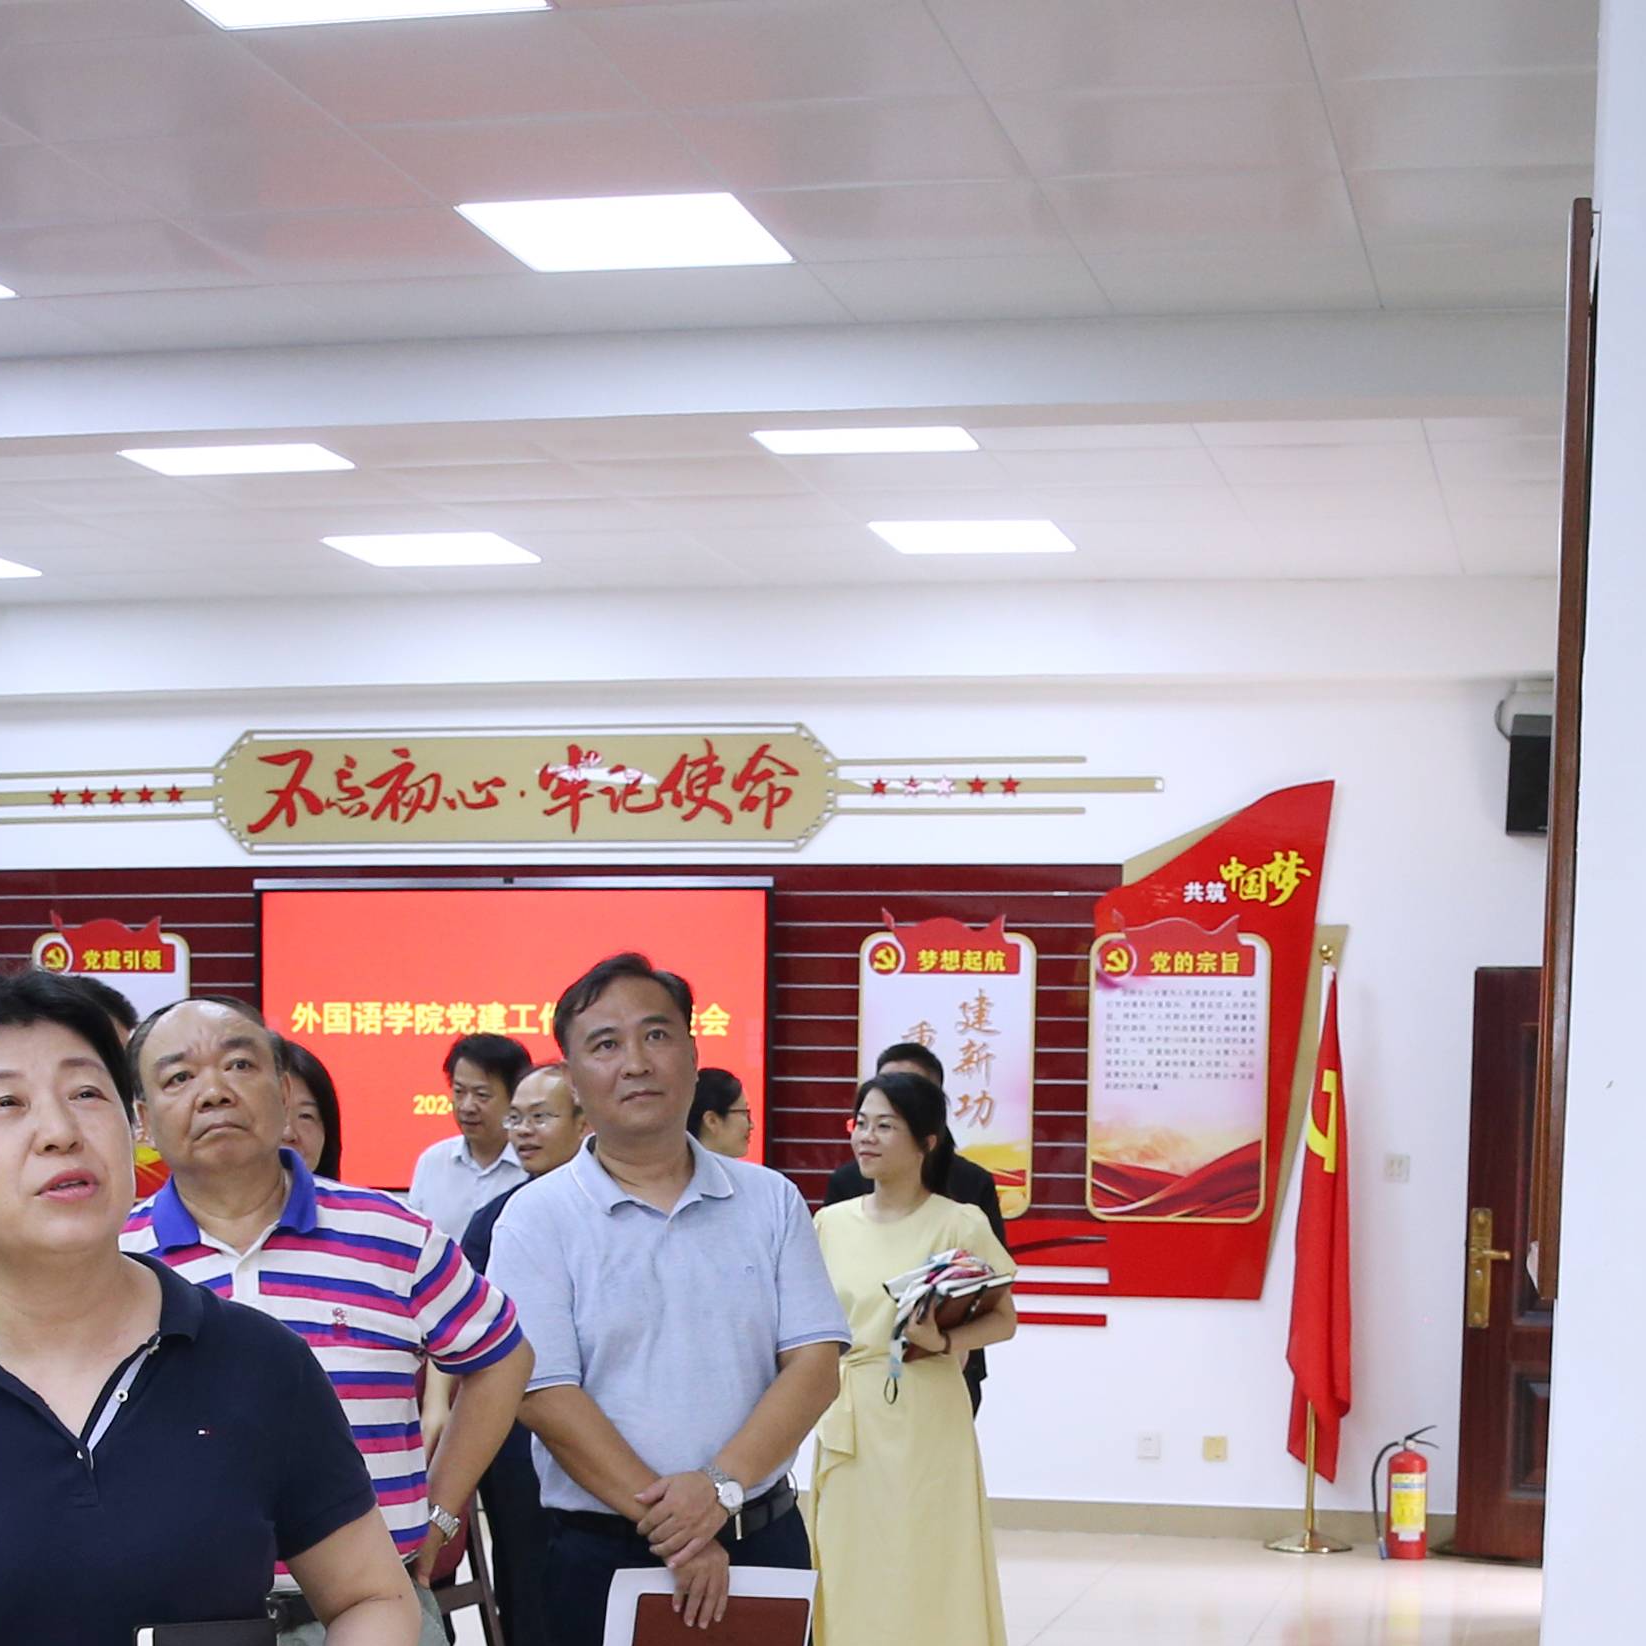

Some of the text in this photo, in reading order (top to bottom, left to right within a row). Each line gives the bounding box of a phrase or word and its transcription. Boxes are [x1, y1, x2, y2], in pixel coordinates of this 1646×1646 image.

[1182, 850, 1312, 907] 共筑 中国梦
[82, 948, 163, 972] 党建引领
[917, 949, 1006, 973] 梦想起航
[1150, 951, 1240, 974] 党的宗旨
[953, 988, 1001, 1130] 建新功
[412, 1094, 454, 1116] 202
